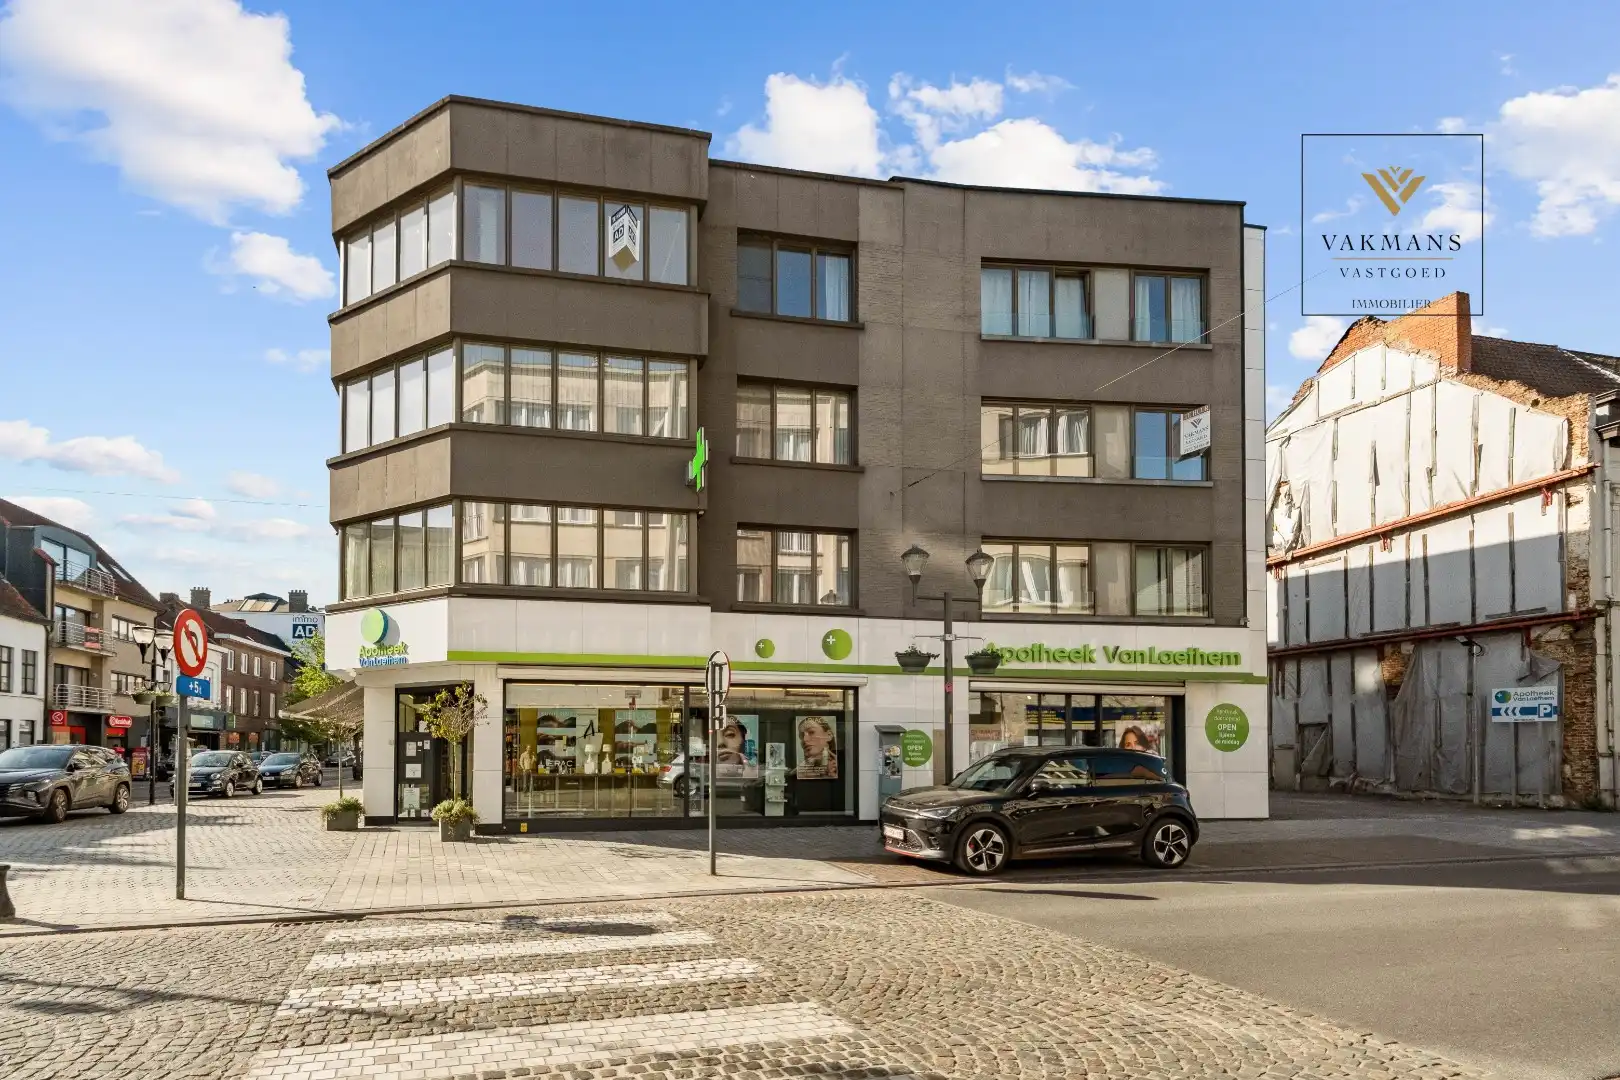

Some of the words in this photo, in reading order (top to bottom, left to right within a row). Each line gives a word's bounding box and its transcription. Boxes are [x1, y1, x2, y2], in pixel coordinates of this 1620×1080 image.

[292, 615, 318, 623] immo
[358, 642, 407, 658] Apotheek
[1513, 690, 1555, 699] Apotheek
[1540, 705, 1551, 716] P
[1217, 723, 1237, 731] OPEN
